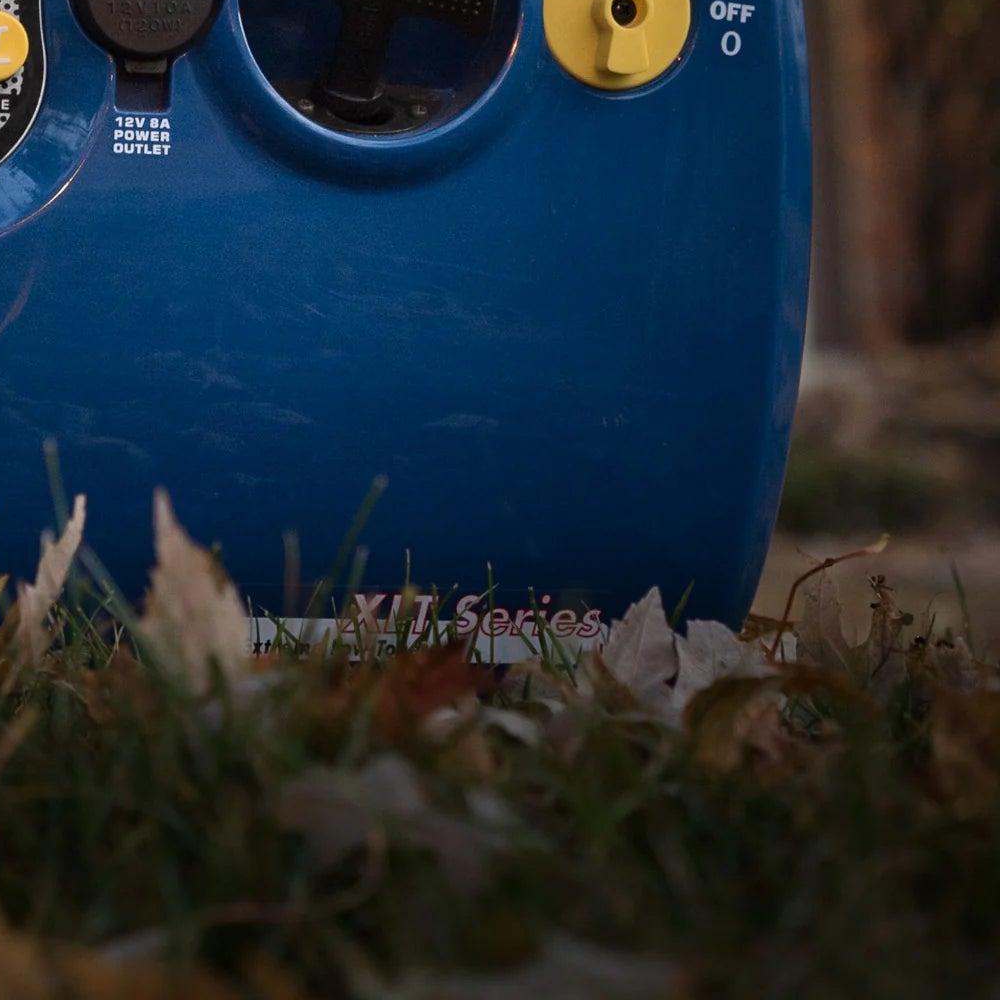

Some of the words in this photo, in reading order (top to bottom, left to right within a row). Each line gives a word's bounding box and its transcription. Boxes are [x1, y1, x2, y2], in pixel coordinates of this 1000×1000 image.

[709, 0, 756, 24] OFF
[115, 116, 145, 128] 12V
[150, 117, 171, 130] 8A
[114, 129, 171, 142] POWER
[113, 142, 171, 155] OUTLET
[455, 593, 602, 638] Series
